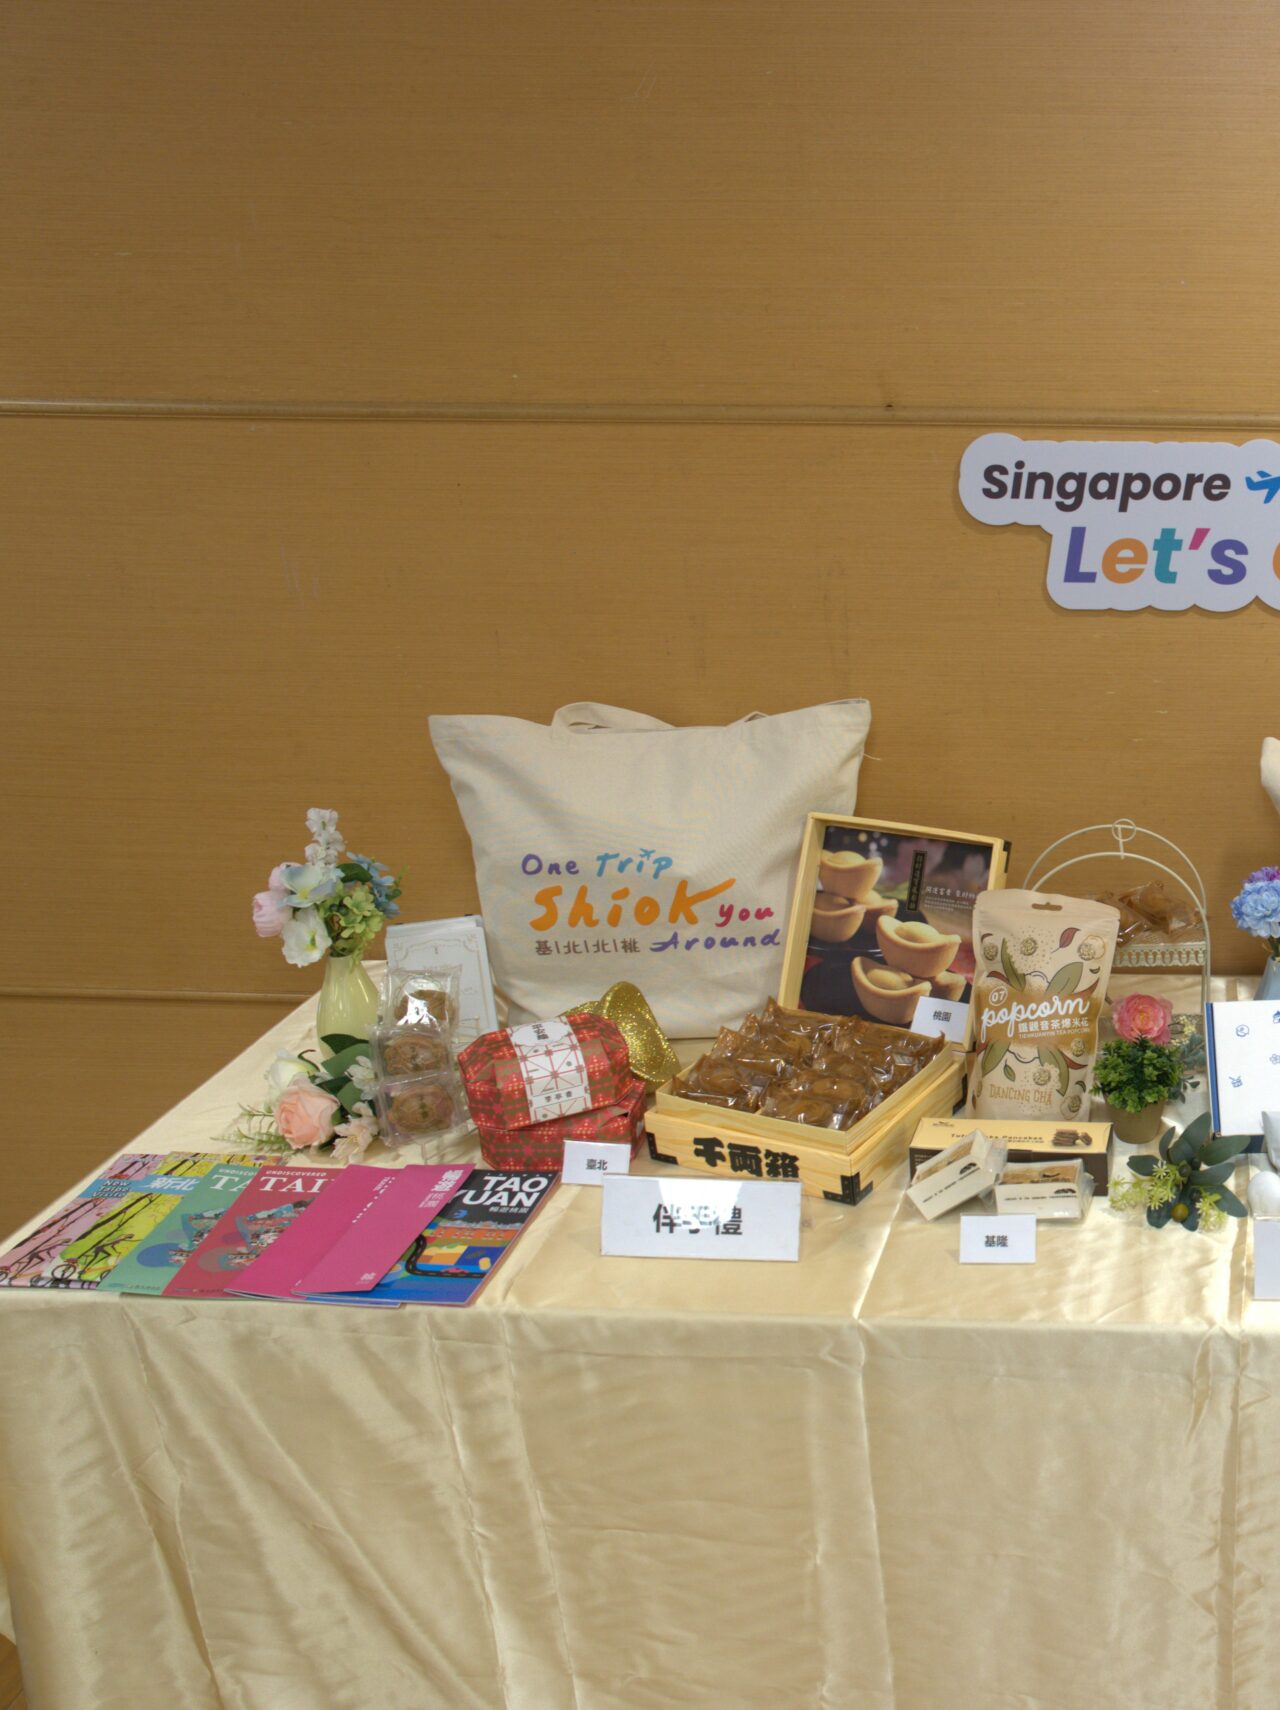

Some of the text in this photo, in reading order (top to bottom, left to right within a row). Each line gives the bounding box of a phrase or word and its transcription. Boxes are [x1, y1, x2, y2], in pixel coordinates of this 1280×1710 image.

[982, 460, 1231, 512] Singapore
[1063, 526, 1249, 586] Let's
[521, 848, 674, 880] One Trip
[715, 903, 775, 928] you
[649, 928, 781, 952] Around
[991, 990, 1006, 1002] 07
[933, 1010, 952, 1022] 桃園
[981, 995, 1090, 1043] popcorn
[989, 1083, 1031, 1102] DANCING
[144, 1177, 202, 1191] 新北
[259, 1176, 335, 1193] TAI
[483, 1176, 549, 1192] TAO
[985, 1235, 1009, 1248] 基隆
